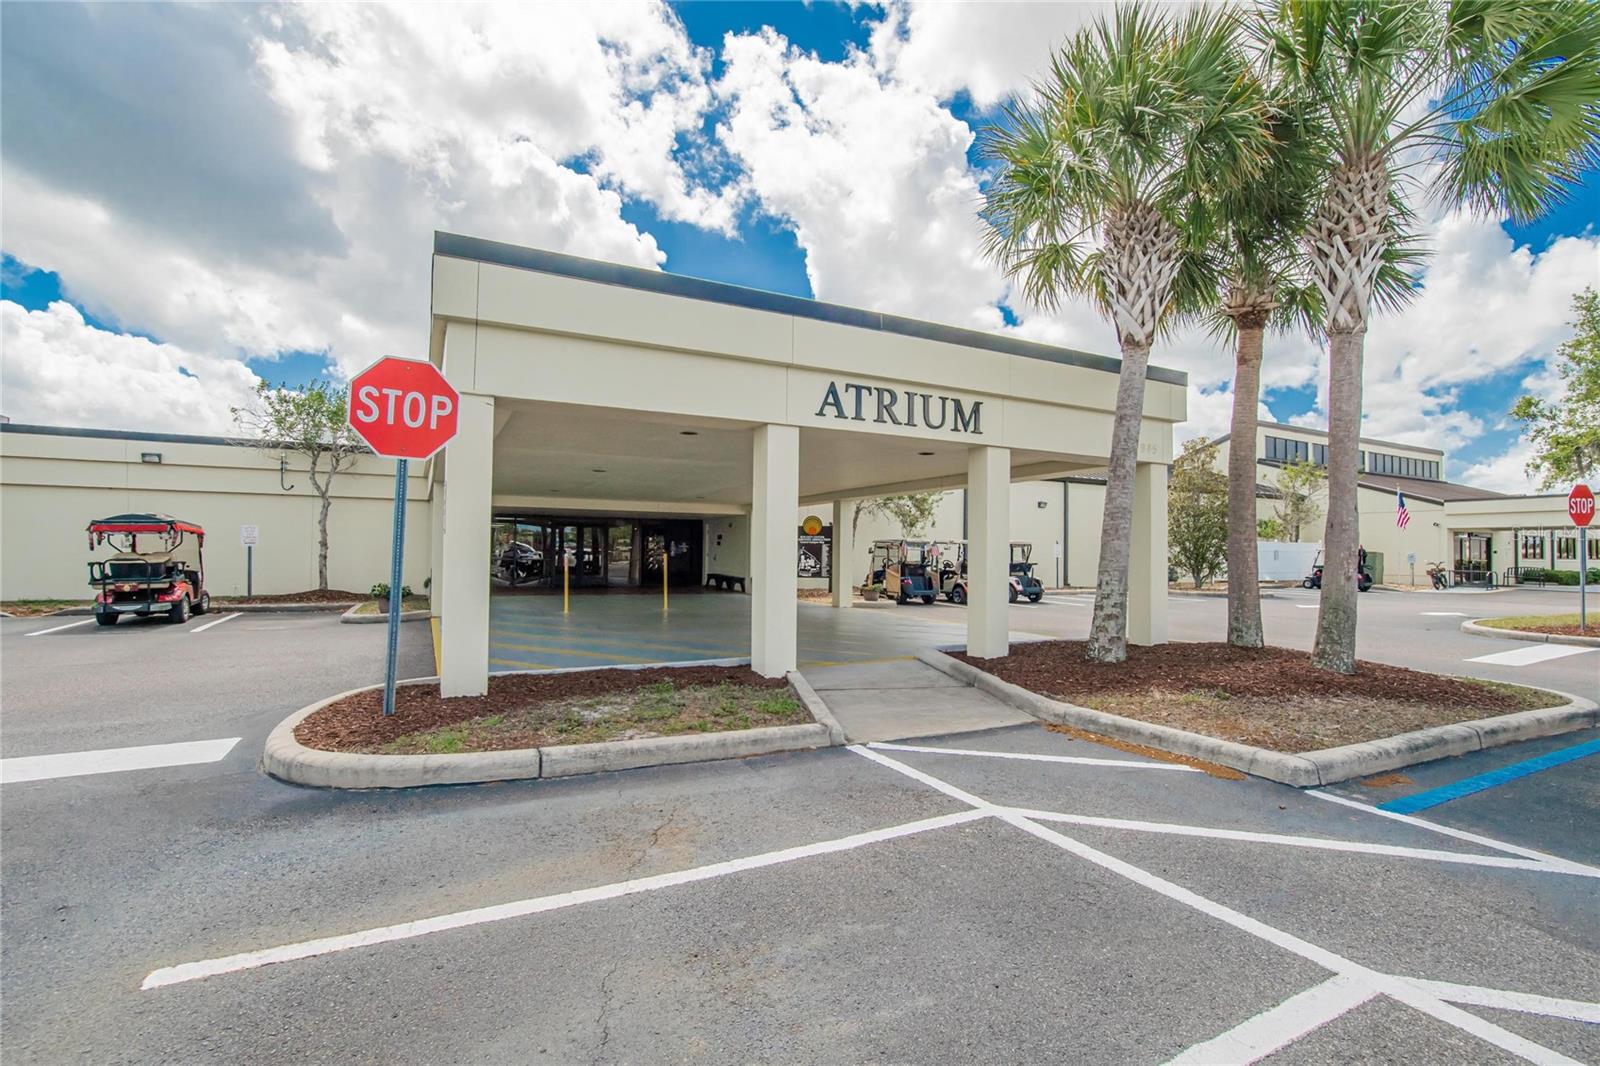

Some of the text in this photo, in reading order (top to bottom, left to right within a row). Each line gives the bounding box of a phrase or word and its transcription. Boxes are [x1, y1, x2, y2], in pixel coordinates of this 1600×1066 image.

[356, 385, 453, 429] STOP
[815, 381, 983, 434] ATRIUM
[1570, 498, 1593, 514] STOP
